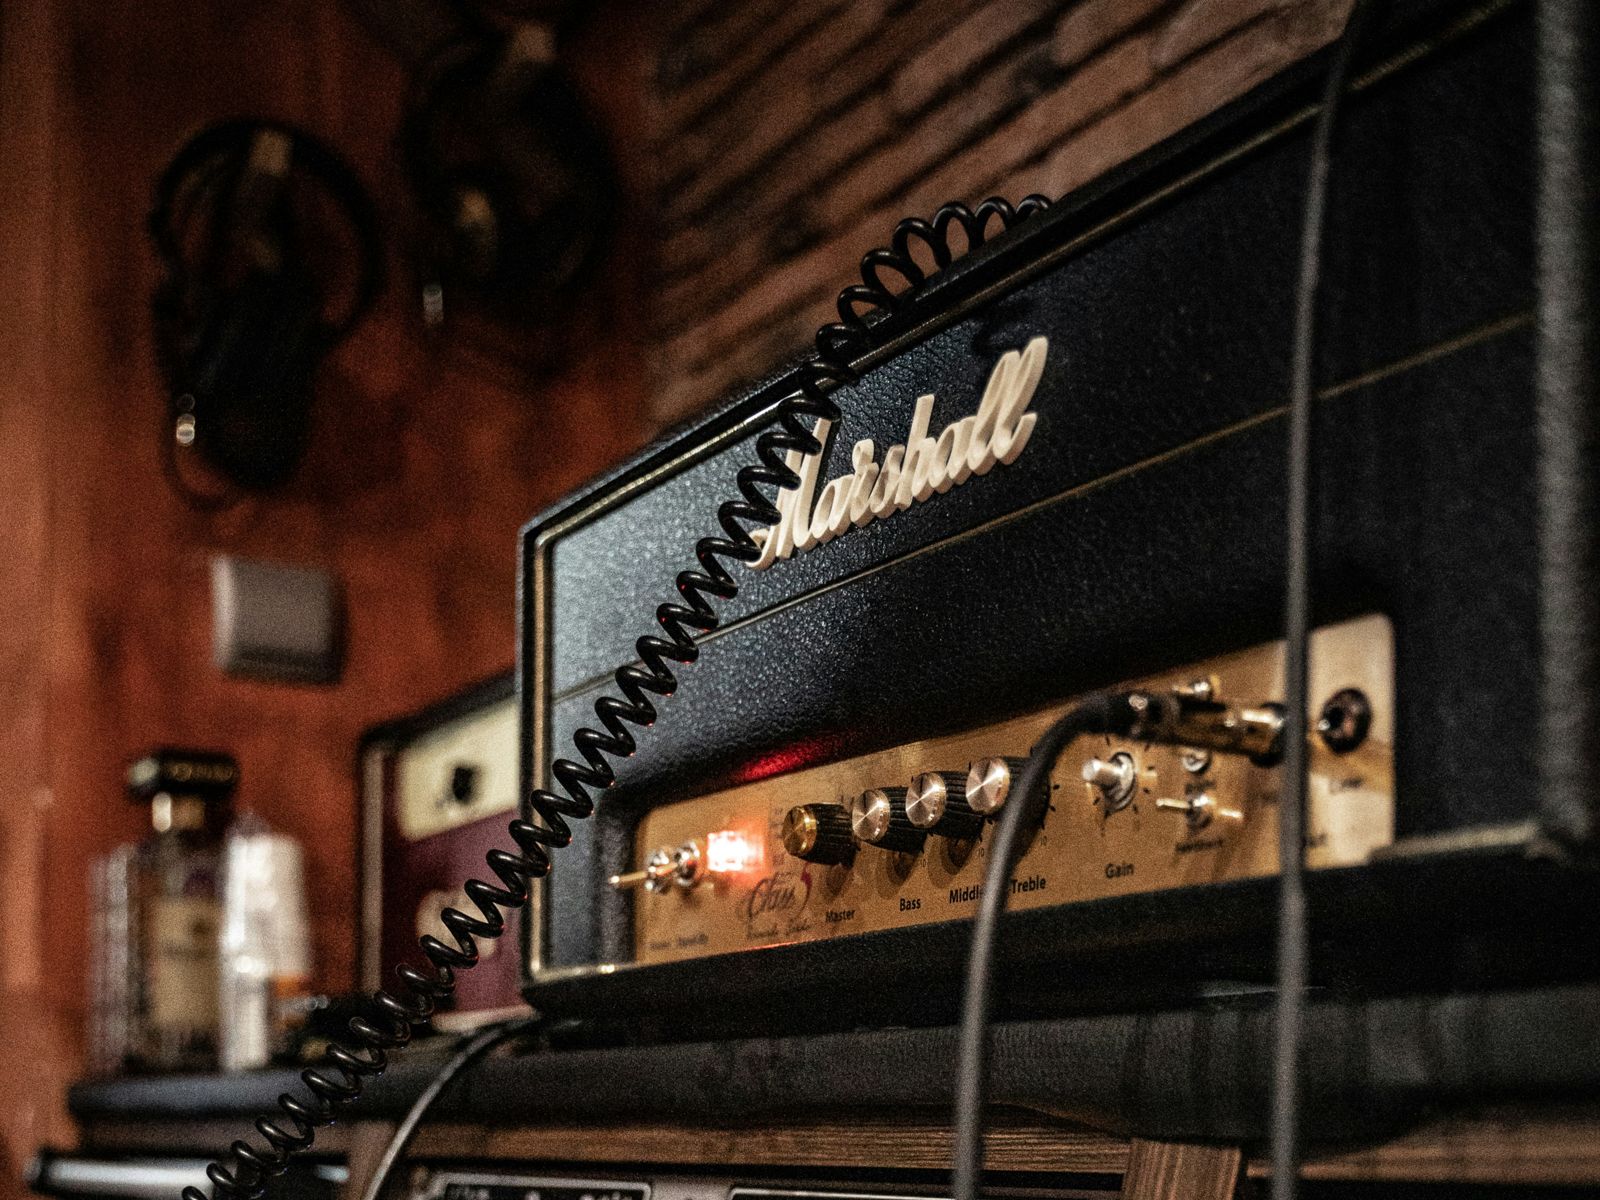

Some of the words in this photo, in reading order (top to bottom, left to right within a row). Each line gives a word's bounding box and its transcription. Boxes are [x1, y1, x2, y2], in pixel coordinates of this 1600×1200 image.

[746, 336, 1048, 570] Marshall
[1105, 861, 1135, 878] Gain
[1011, 875, 1046, 893] Treble
[950, 885, 984, 904] Middl
[900, 897, 921, 911] Bass
[825, 908, 856, 922] Master
